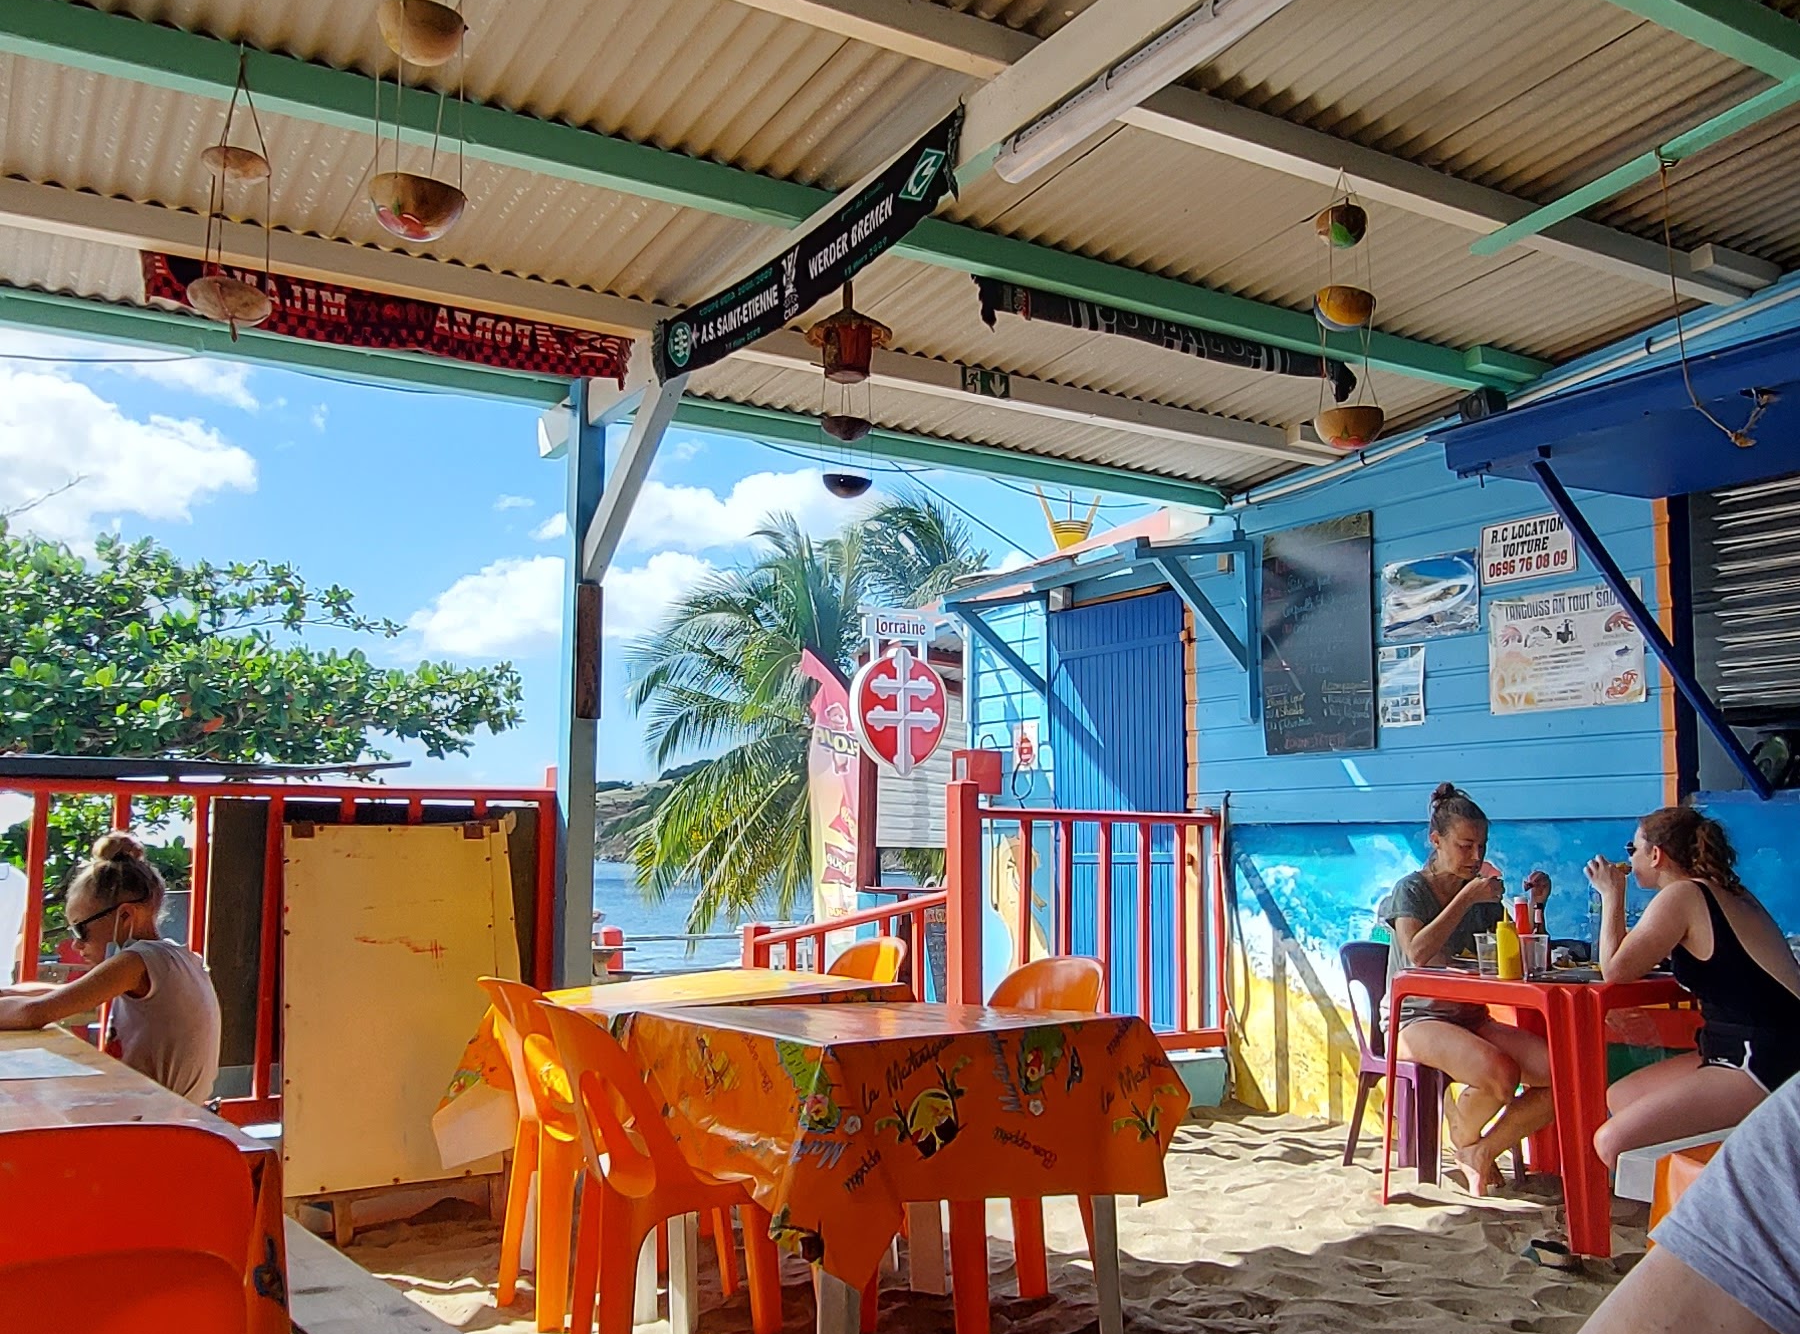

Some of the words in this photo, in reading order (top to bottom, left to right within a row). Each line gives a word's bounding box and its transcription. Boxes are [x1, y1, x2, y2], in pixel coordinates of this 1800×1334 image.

[808, 231, 849, 280] WERDER
[850, 192, 893, 249] BREMEN
[716, 283, 780, 340] SAINT-ETIENNE
[783, 304, 799, 320] CUP
[1511, 516, 1564, 540] LOCATION
[1502, 536, 1550, 559] VOITURE
[1488, 560, 1515, 578] 0696
[1518, 557, 1533, 573] 76
[1536, 553, 1550, 569] 08
[1553, 549, 1568, 566] 09
[1506, 600, 1550, 622] LANGOUSS
[1552, 596, 1566, 614] AN
[875, 618, 927, 637] Lorraine
